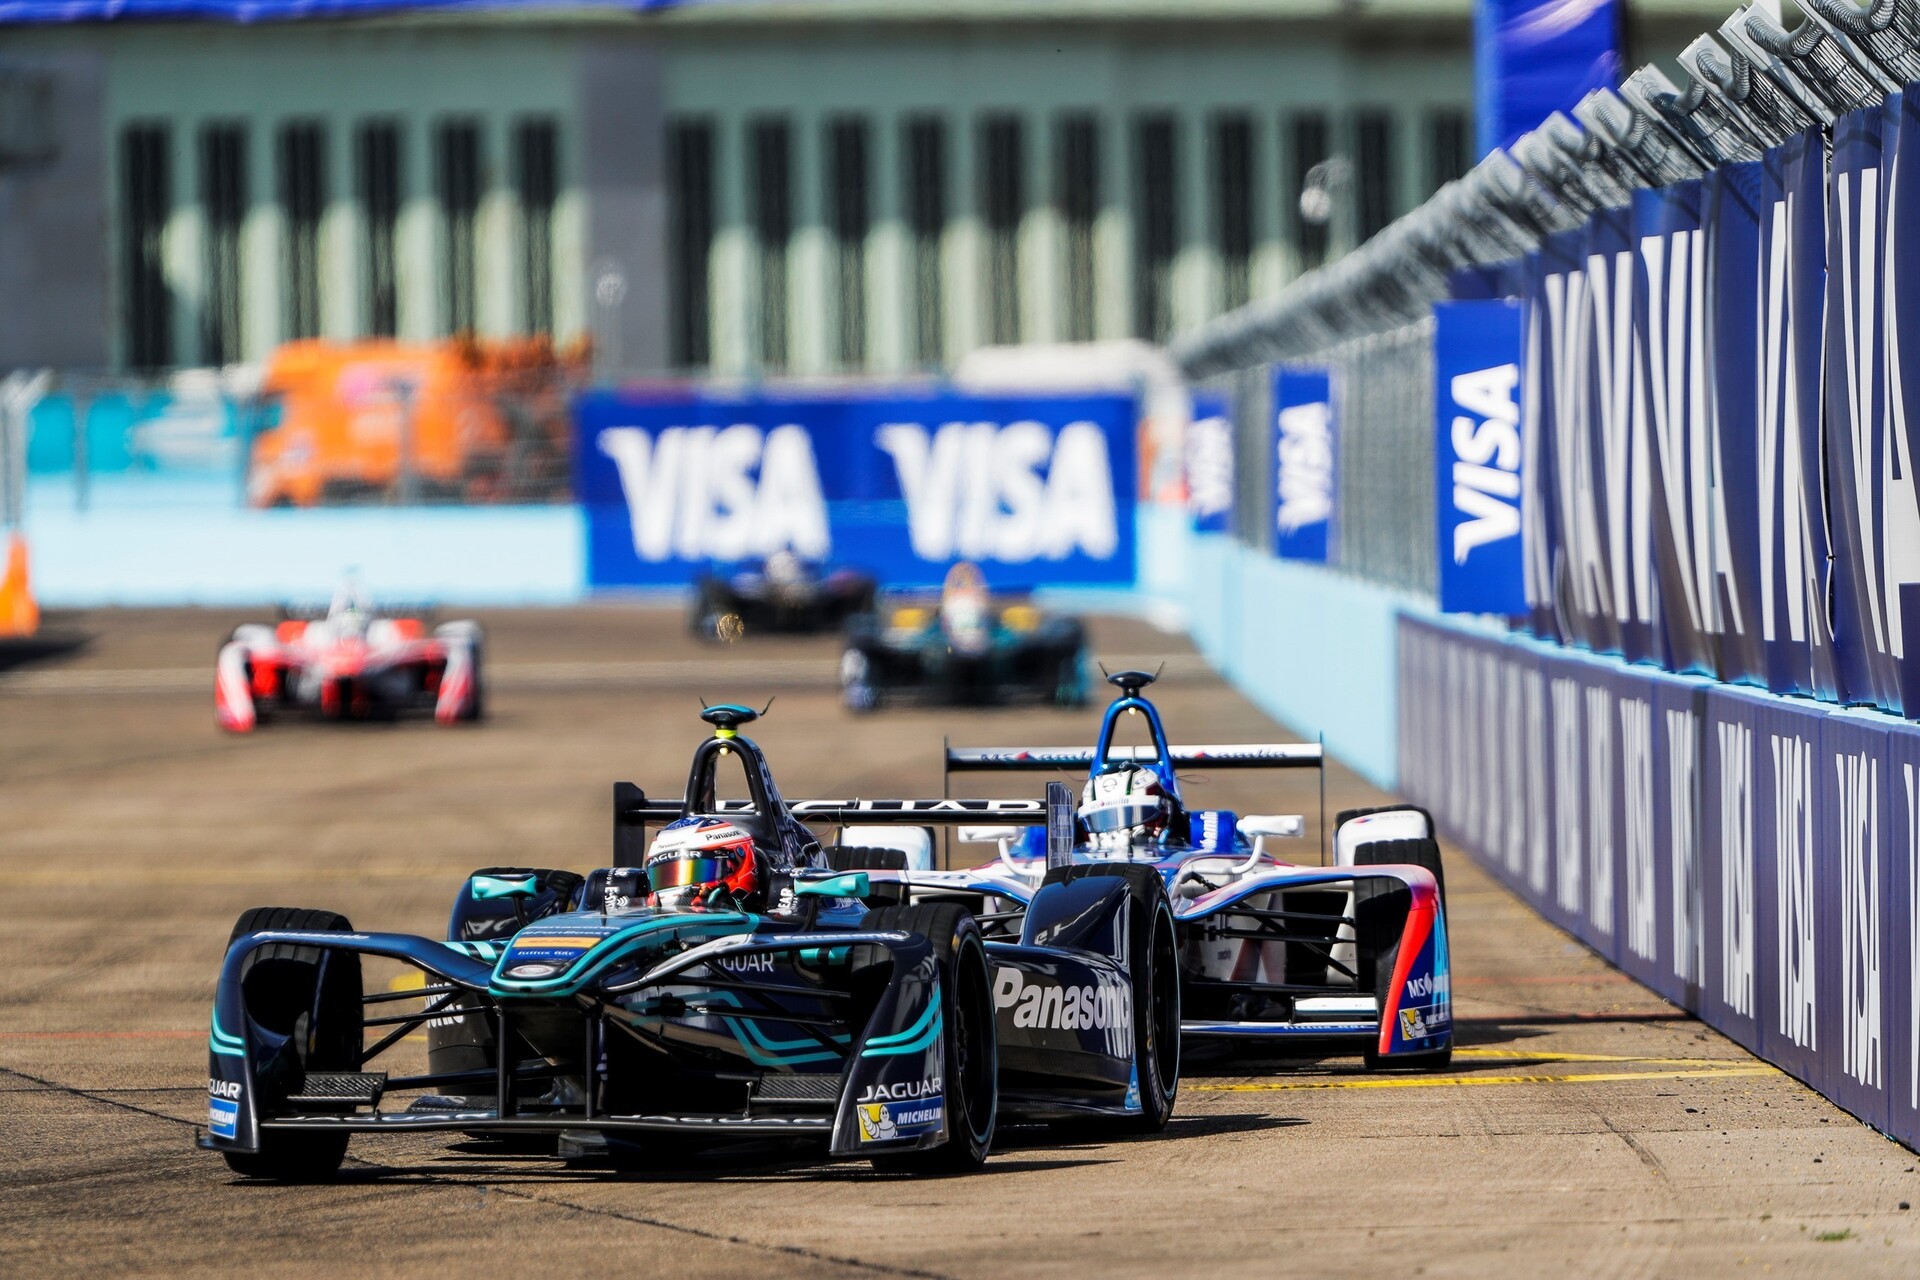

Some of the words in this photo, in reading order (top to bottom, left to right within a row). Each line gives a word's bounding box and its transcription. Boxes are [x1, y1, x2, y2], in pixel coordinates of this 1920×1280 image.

[597, 422, 832, 562] VISA
[873, 420, 1118, 561] VISA
[1451, 362, 1520, 567] VISA
[1666, 709, 1705, 988] VISA
[1718, 721, 1754, 1019] VISA
[1771, 734, 1816, 1052] VISA
[1836, 751, 1881, 1090] VISA
[992, 966, 1129, 1031] Panasonic
[856, 1077, 942, 1102] JAGUAR
[896, 1106, 944, 1125] MICHELIN
